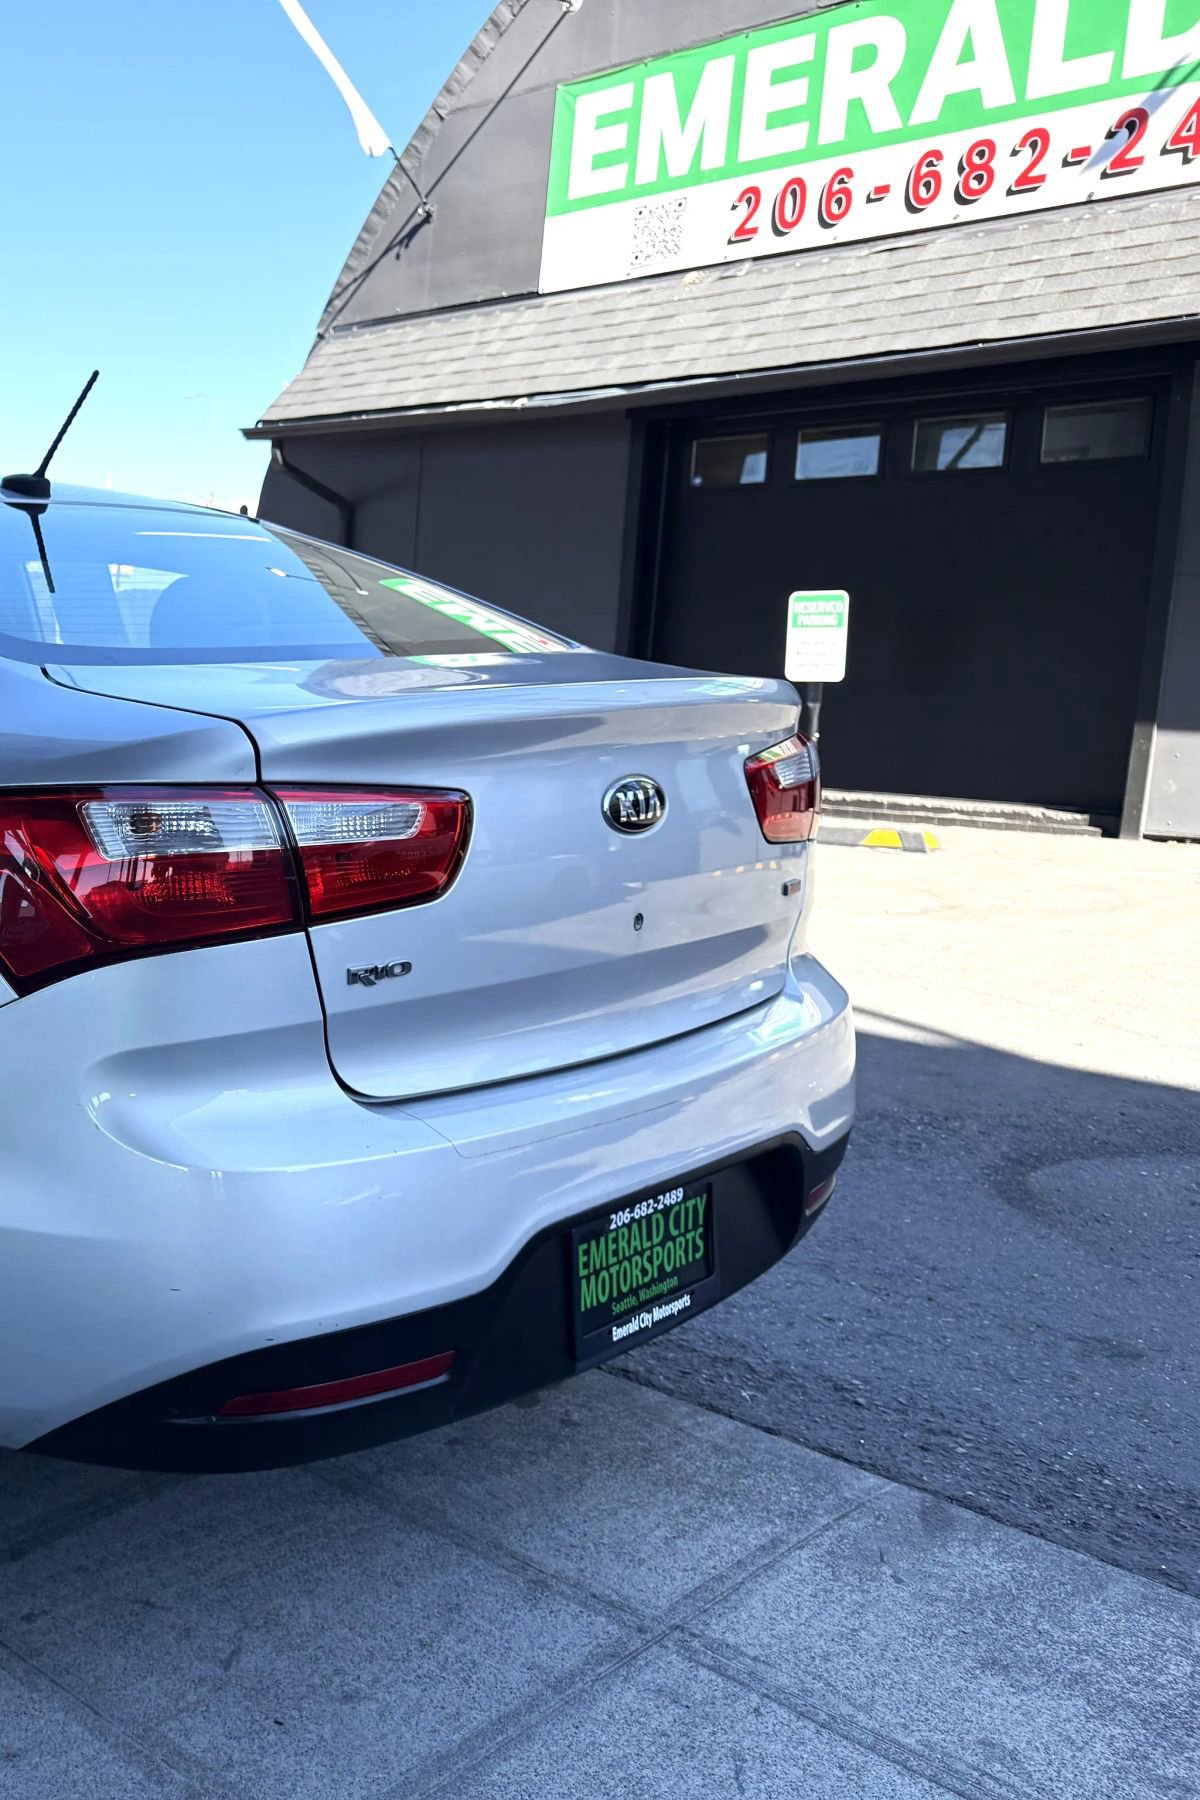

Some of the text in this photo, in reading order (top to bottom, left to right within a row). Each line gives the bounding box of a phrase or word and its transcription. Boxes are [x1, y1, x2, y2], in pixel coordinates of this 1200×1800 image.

[793, 600, 844, 614] RESERVED
[797, 613, 838, 627] PARKING
[615, 787, 663, 823] KIA
[346, 960, 412, 986] RIO
[610, 1187, 684, 1230] 206-682-2489
[578, 1193, 707, 1277] EMERALD CITY
[580, 1227, 704, 1312] MOTORSPORTS
[611, 1275, 678, 1316] Seattle, Washington
[612, 1293, 691, 1342] Emerald City Motorsports
